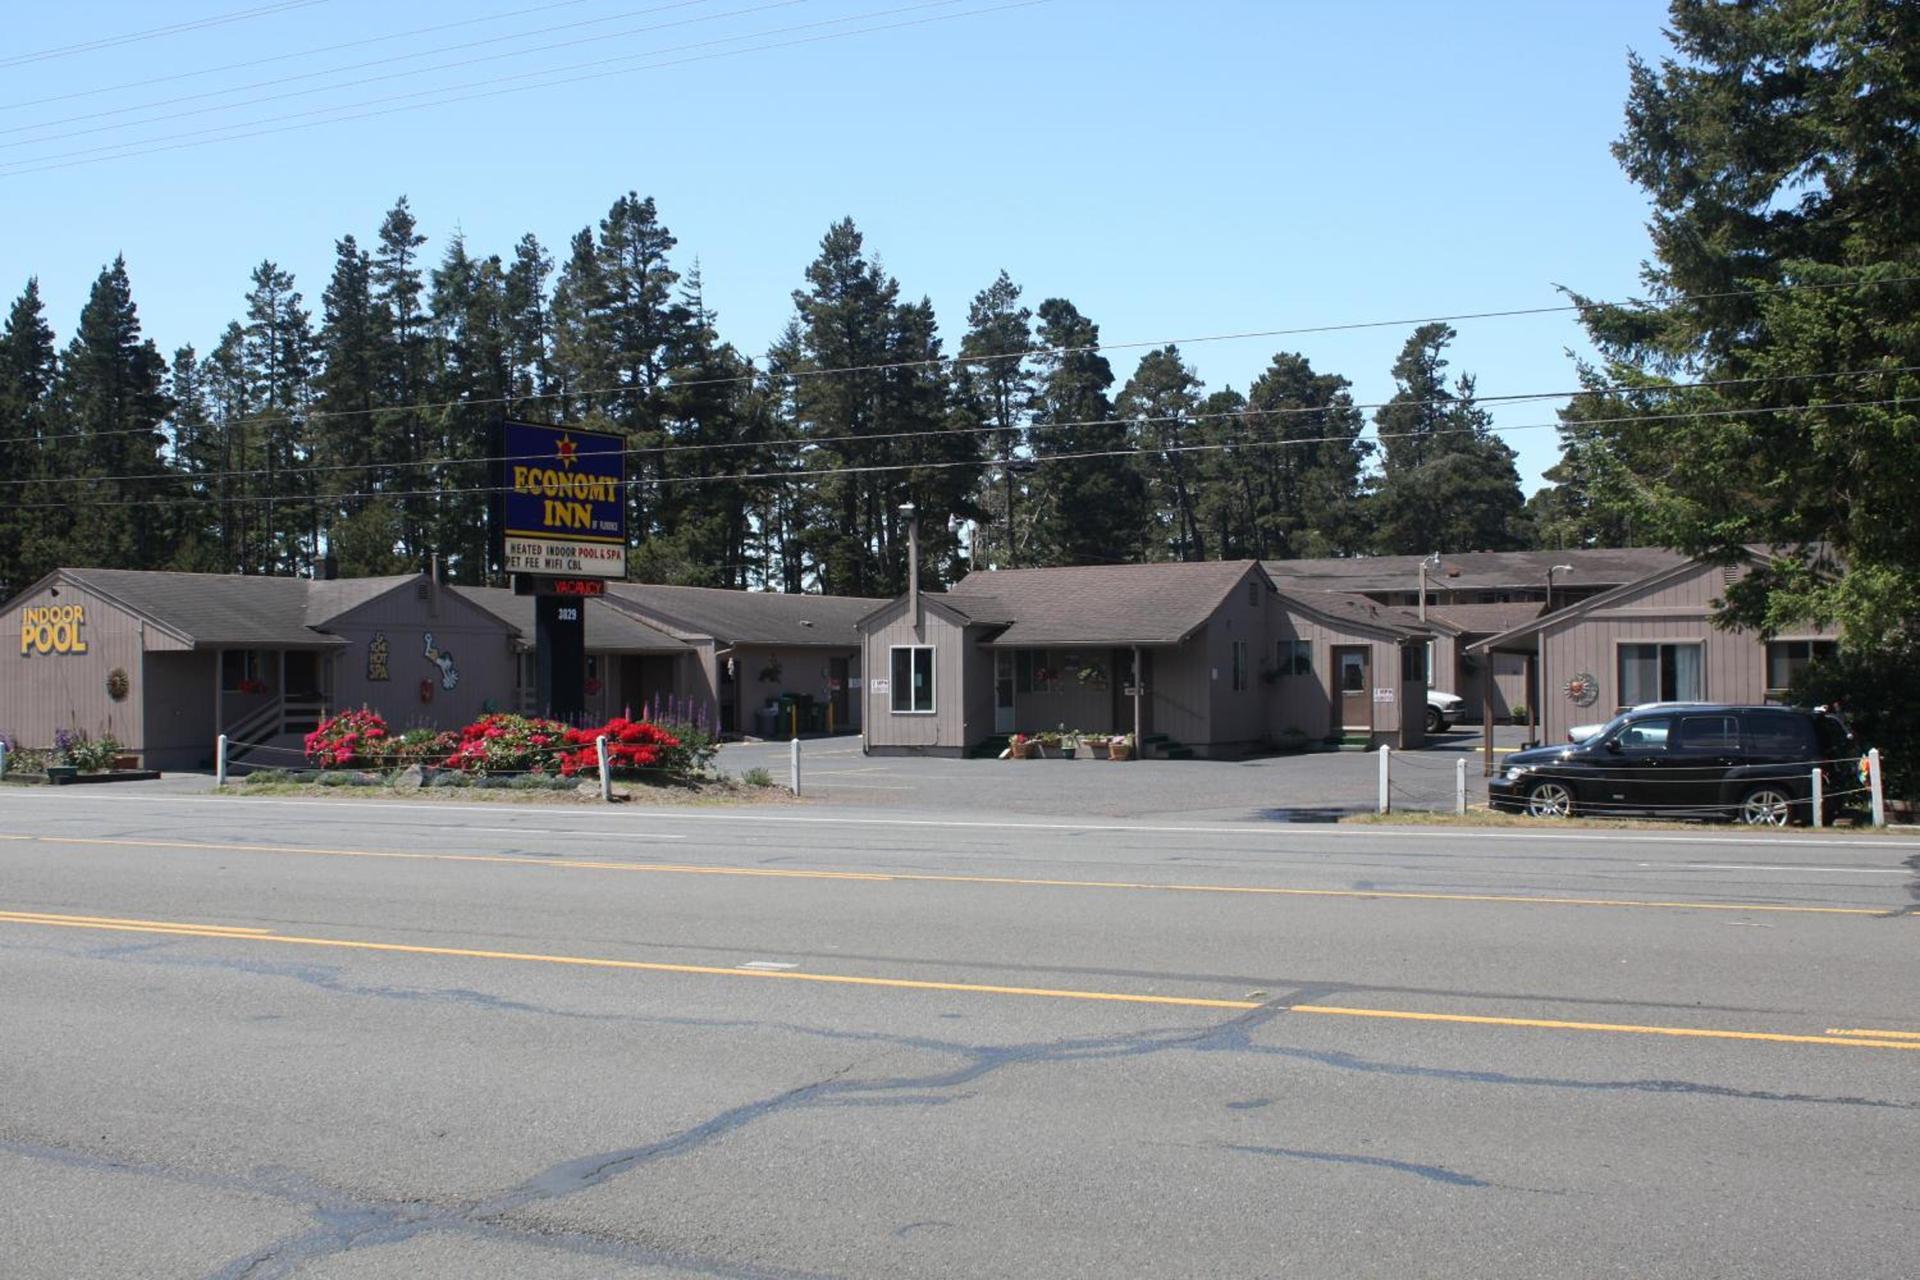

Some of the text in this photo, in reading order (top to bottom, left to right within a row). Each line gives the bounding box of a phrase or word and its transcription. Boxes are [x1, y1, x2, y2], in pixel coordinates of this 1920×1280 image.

[512, 466, 618, 502] ECONOMY
[543, 499, 592, 529] INN
[510, 543, 542, 555] HEATED
[546, 545, 576, 558] INDOOR
[577, 548, 599, 559] POOL
[606, 550, 621, 560] SPA
[525, 557, 540, 568] FEE
[545, 558, 563, 569] WIFI
[554, 580, 602, 594] VACANCY
[22, 605, 85, 626] INDOOR
[20, 622, 88, 657] POOL
[369, 652, 387, 664] HOT
[369, 664, 388, 680] SPA
